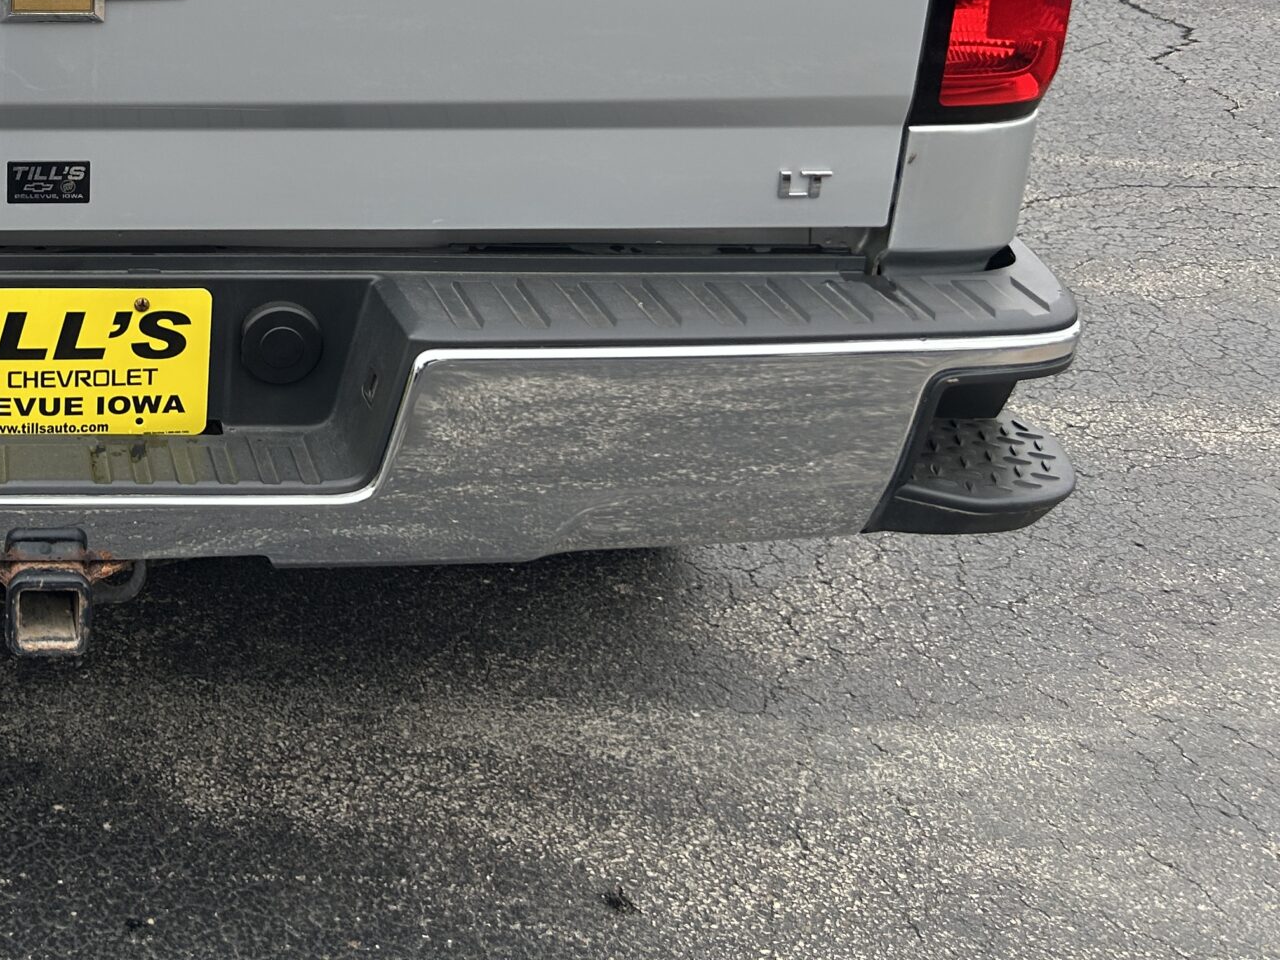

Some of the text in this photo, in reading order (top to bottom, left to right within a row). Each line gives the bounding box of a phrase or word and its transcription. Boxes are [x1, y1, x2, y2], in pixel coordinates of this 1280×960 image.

[12, 166, 86, 181] TILL'S
[777, 169, 833, 199] LT
[7, 368, 159, 389] CHEVROLET
[96, 394, 186, 415] IOWA
